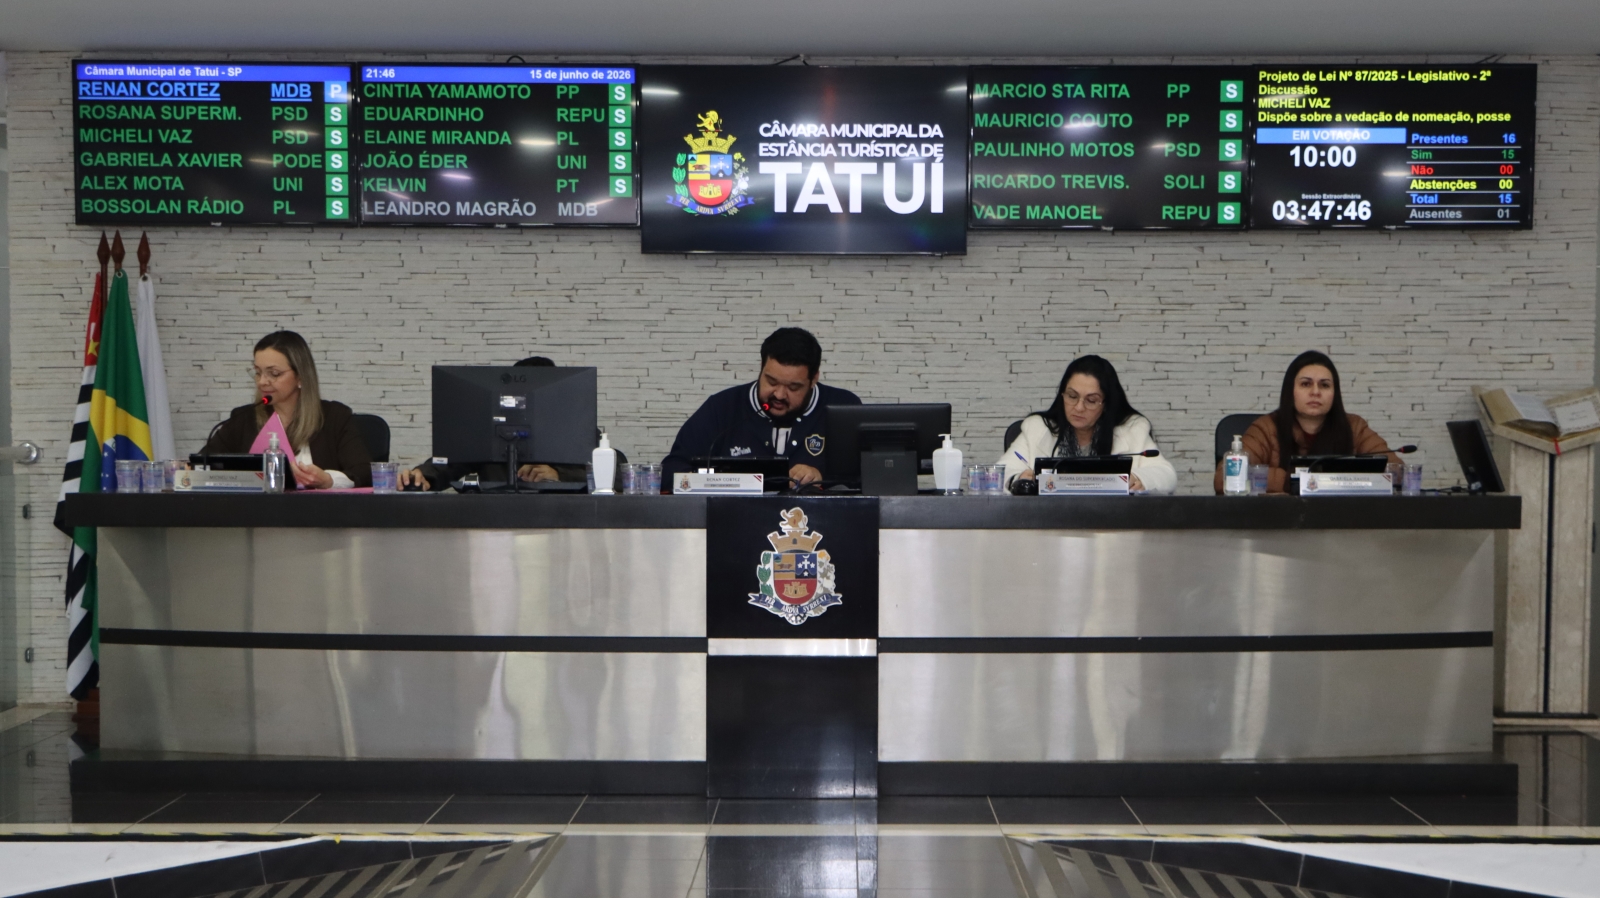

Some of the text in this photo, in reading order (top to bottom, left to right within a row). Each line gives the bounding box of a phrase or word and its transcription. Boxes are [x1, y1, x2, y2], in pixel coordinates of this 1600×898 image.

[84, 66, 124, 76] Câmara
[126, 66, 176, 78] Municipal
[178, 67, 191, 76] de
[194, 67, 218, 77] Tatuí
[228, 68, 242, 77] SP
[366, 69, 395, 79] 21:46
[530, 70, 631, 81] 15 de junho de 2026
[1259, 72, 1300, 84] Projeto
[1302, 72, 1316, 81] de
[1319, 72, 1336, 81] Lei
[1355, 71, 1398, 81] 87/2025
[1408, 71, 1470, 83] Legislativo
[1480, 71, 1491, 81] 2ª
[79, 82, 342, 98] RENAN CORTEZ MDB P
[363, 84, 626, 100] CINTIA YAMAMOTO PP S
[974, 84, 1237, 98] MARCIO STA RITA PP S
[1259, 85, 1317, 95] Discussão
[1258, 98, 1330, 108] MICHELI VAZ
[79, 105, 342, 122] ROSANA SUPERM. PSD S
[364, 107, 626, 124] EDUARDINHO REPU S
[974, 113, 1236, 128] MAURICIO COUTO PP S
[1258, 112, 1511, 124] Dispõe sobre a vedação de nomeação, posse
[759, 120, 943, 138] CÂMARA MUNICIPAL DA
[1292, 129, 1370, 142] EM VOTAÇÃO
[80, 129, 342, 145] MICHELI VAZ PSD S
[364, 130, 626, 146] ELAINE MIRANDA PL S
[1412, 134, 1515, 144] Presentes 16
[759, 140, 943, 158] ESTÂNCIA TURÍSTICA DE
[974, 143, 1236, 157] PAULINHO MOTOS PSD S
[1290, 146, 1356, 167] 10:00
[1411, 150, 1514, 160] Sim 15
[80, 152, 342, 169] GABRIELA XAVIER PODE S
[363, 151, 626, 170] JOÃO ÉDER UNI S
[1411, 165, 1513, 175] Não 00
[81, 176, 342, 192] ALEX MOTA UNI S
[364, 178, 626, 194] KELVIN PT S
[759, 158, 944, 214] TATUÍ
[974, 175, 1236, 190] RICARDO TREVIS. SOLI S
[1410, 180, 1512, 191] Abstenções 00
[82, 197, 343, 216] BOSSOLAN RÁDIO PL S
[1410, 194, 1512, 204] Total 15
[364, 199, 598, 217] LEANDRO MAGRÃO MDB
[973, 205, 1235, 220] VADE MANOEL REPU S
[1272, 201, 1371, 221] 03:47:46
[1409, 209, 1510, 219] Ausentes 01
[514, 374, 527, 382] LG
